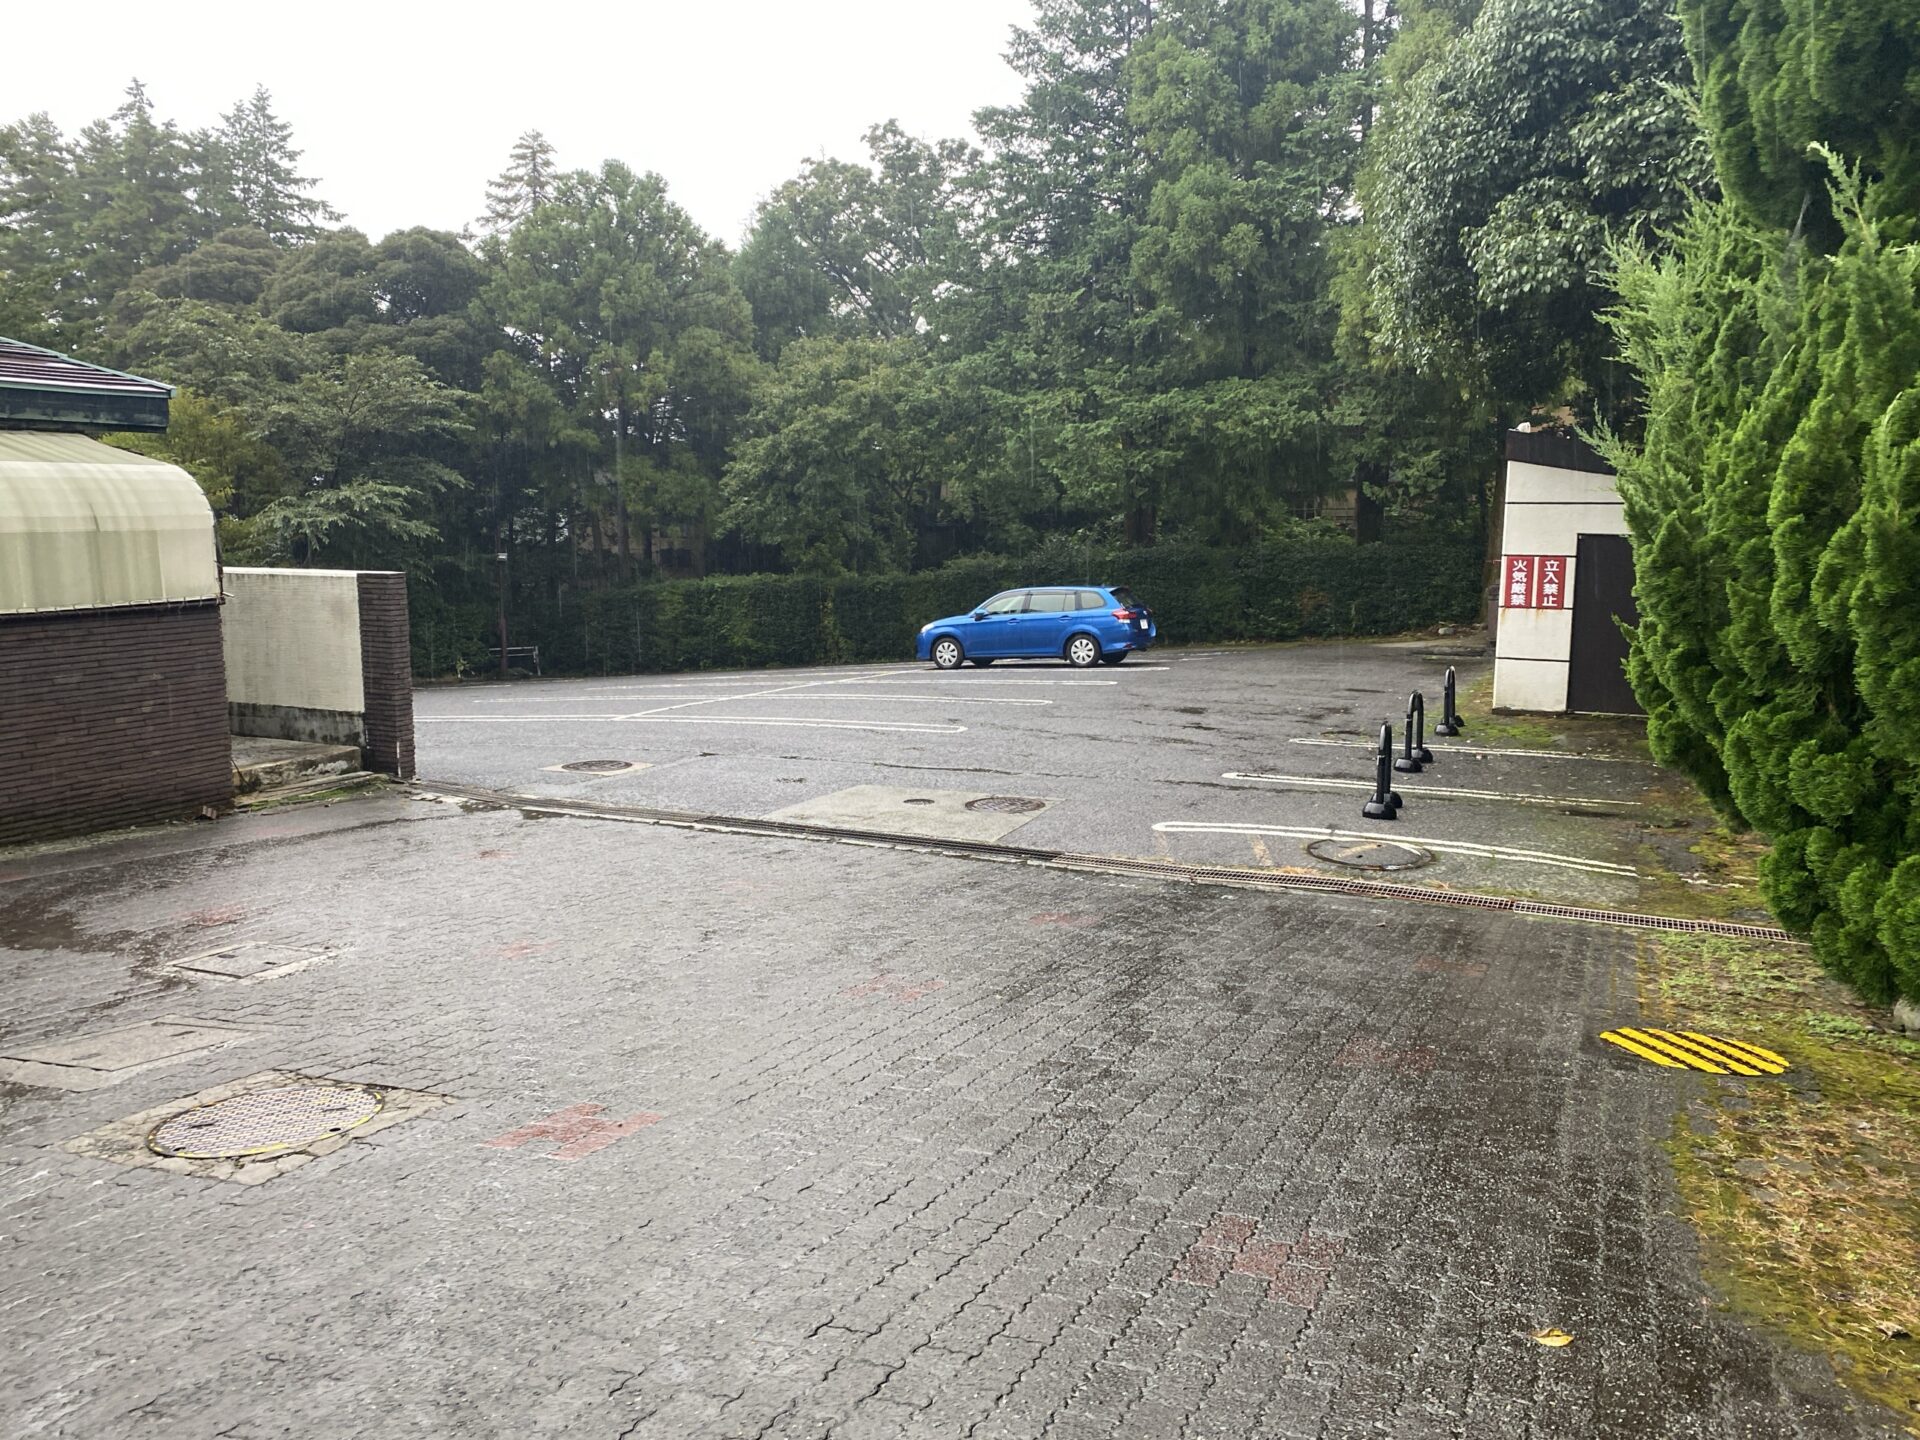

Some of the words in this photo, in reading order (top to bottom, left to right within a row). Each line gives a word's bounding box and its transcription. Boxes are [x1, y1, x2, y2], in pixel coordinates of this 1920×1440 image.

[1510, 560, 1527, 606] 火気厳禁
[1542, 560, 1560, 607] 立入禁止
